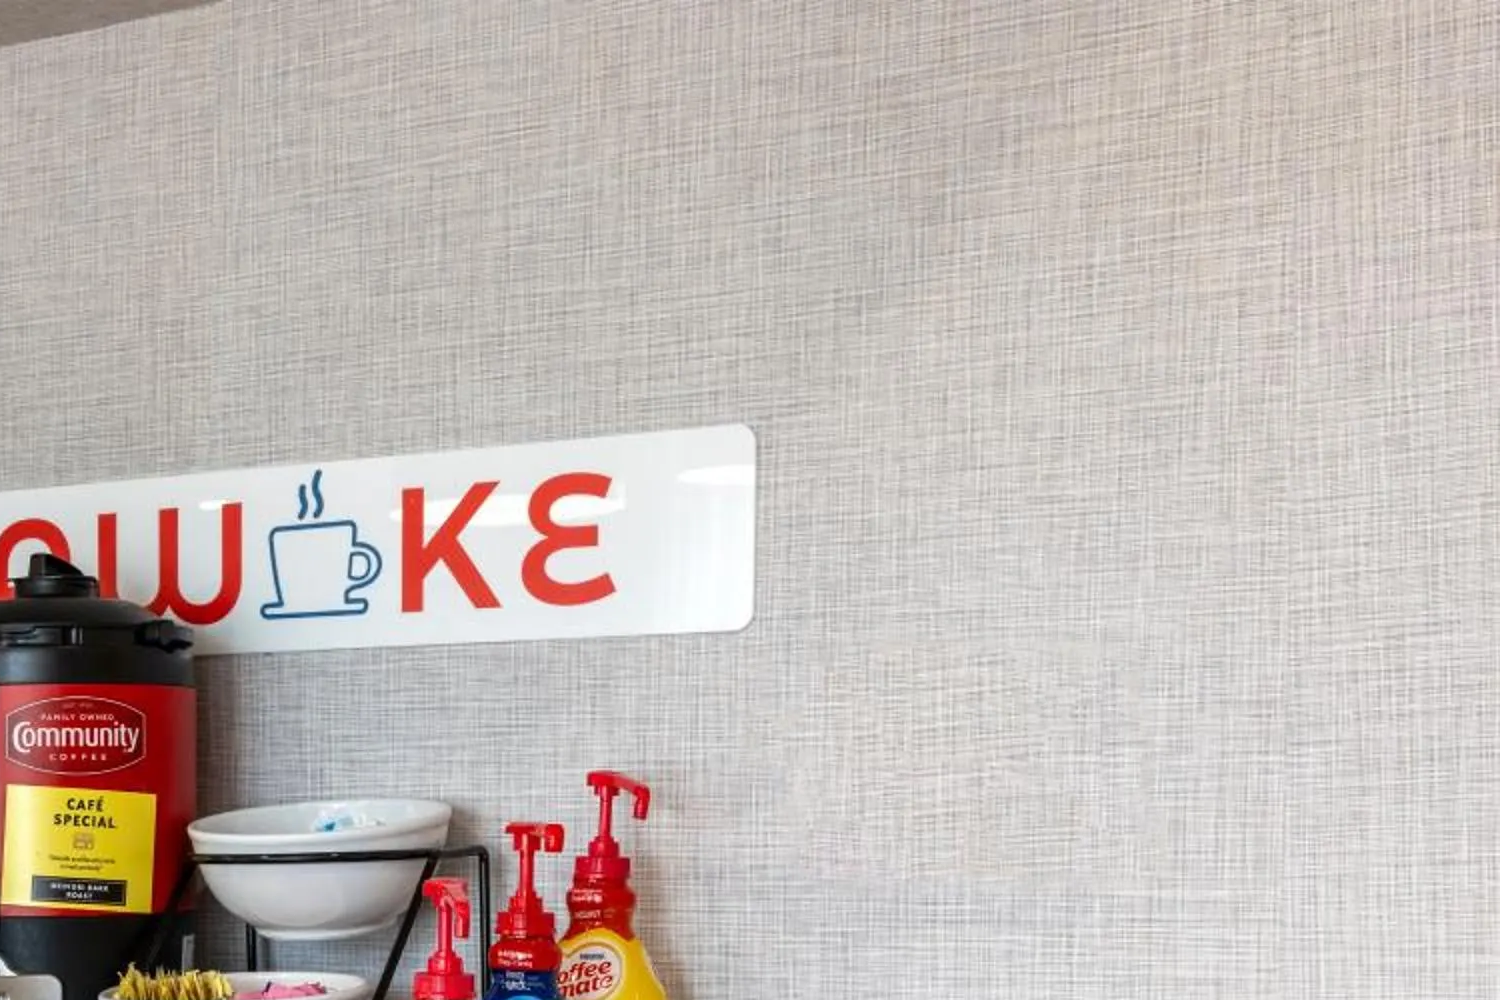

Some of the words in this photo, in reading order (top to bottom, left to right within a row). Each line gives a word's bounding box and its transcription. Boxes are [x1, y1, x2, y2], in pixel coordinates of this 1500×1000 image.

[12, 721, 140, 753] Community
[67, 796, 104, 812] CAFÉ
[53, 813, 116, 829] SPECIAL
[557, 961, 612, 984] offee
